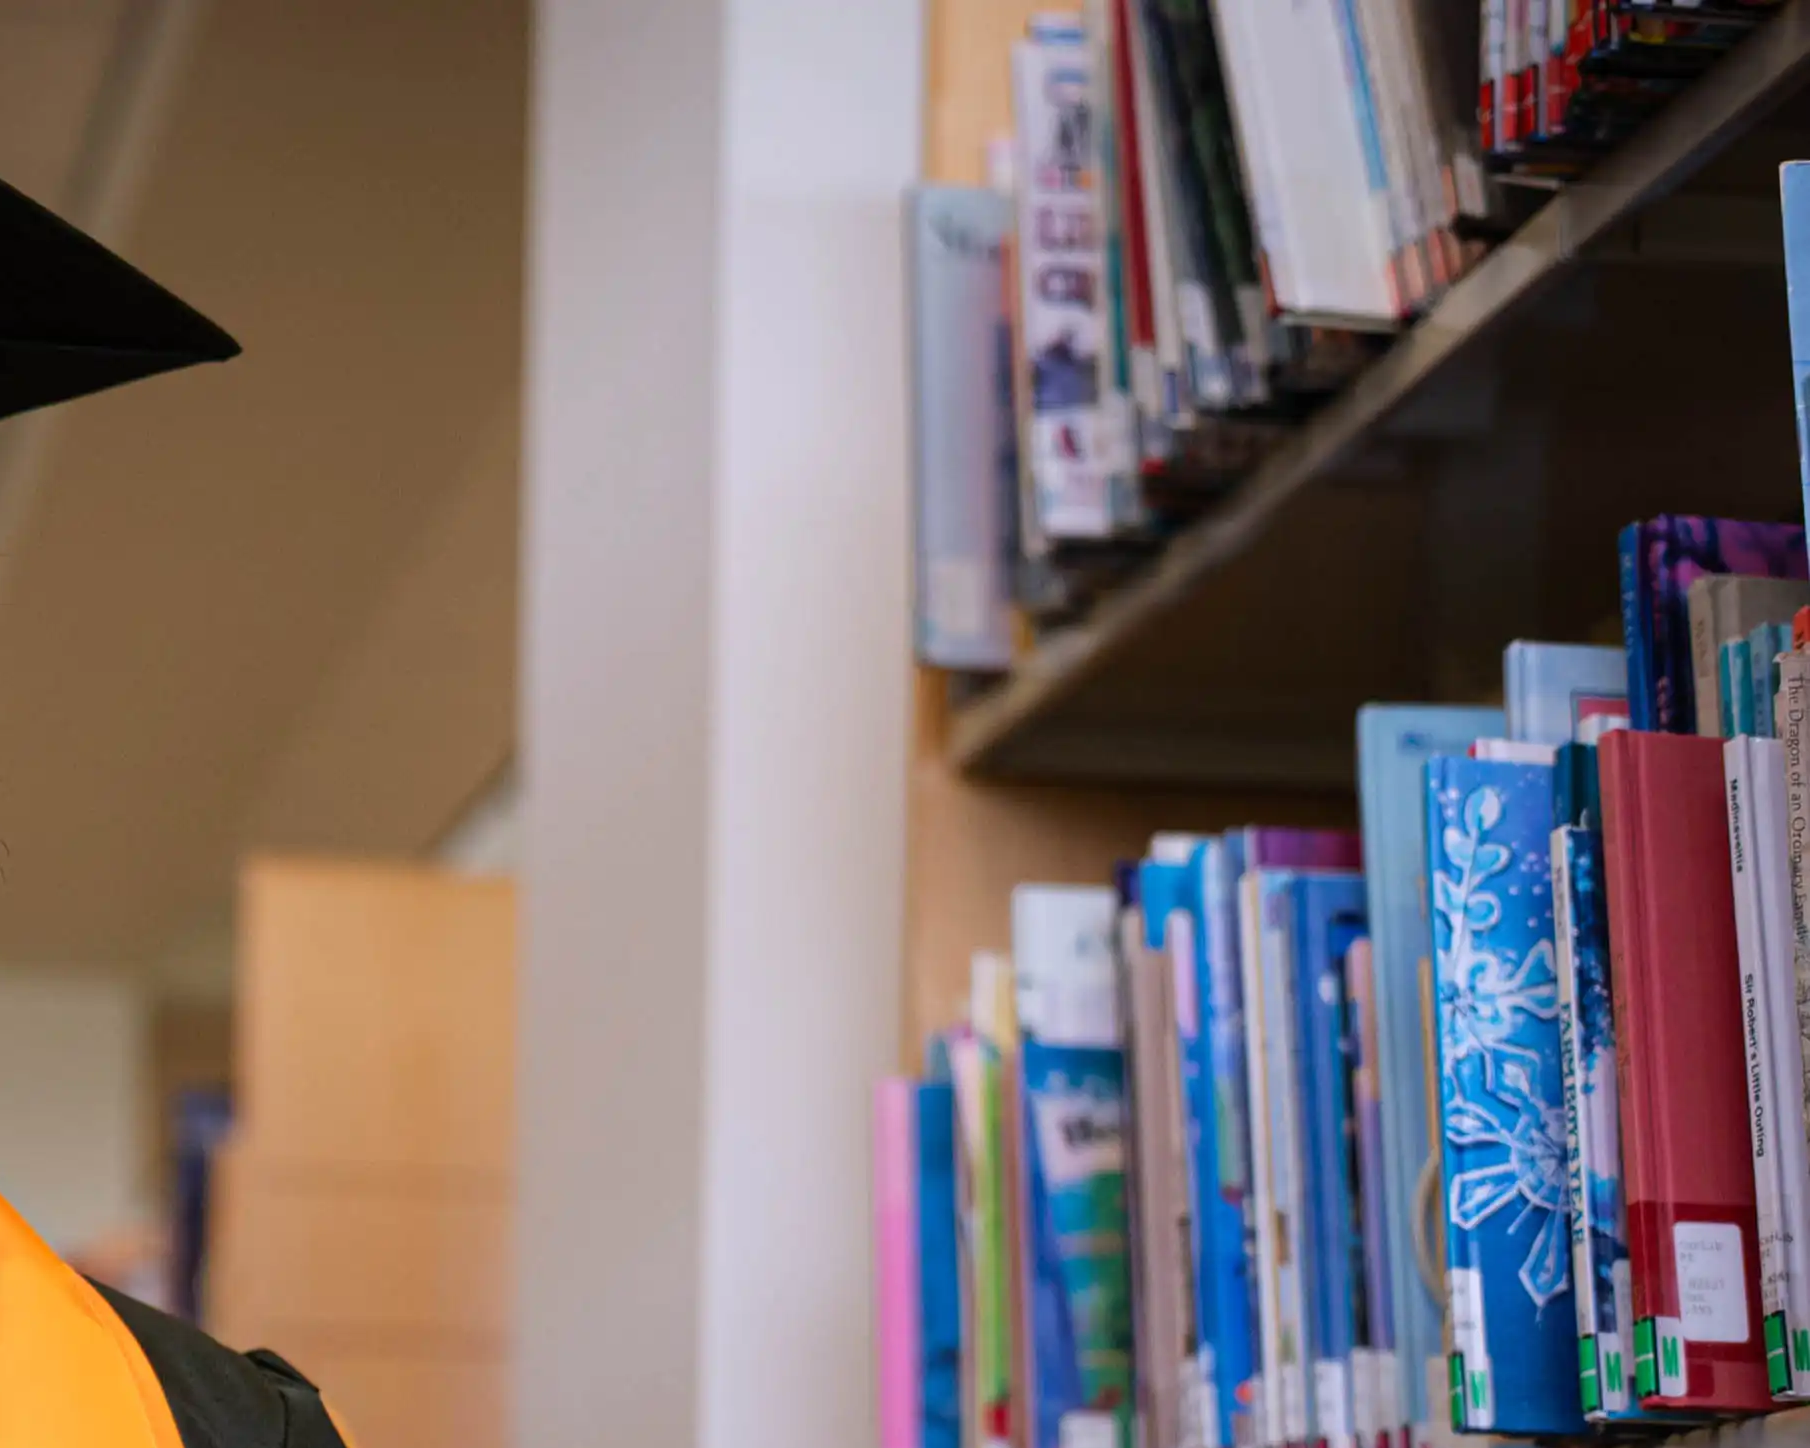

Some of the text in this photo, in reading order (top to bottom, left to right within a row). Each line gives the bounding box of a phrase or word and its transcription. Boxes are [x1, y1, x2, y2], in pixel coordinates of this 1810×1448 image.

[1788, 673, 1805, 704] The
[1787, 708, 1805, 767] Dragon
[1789, 770, 1806, 788] of
[1791, 793, 1803, 812] an
[1745, 973, 1766, 1158] Sir Robert's Little Outing
[1561, 1002, 1577, 1078] FARM
[1570, 1165, 1586, 1245] YEAR
[1606, 1351, 1622, 1393] M
[1662, 1335, 1679, 1377] M
